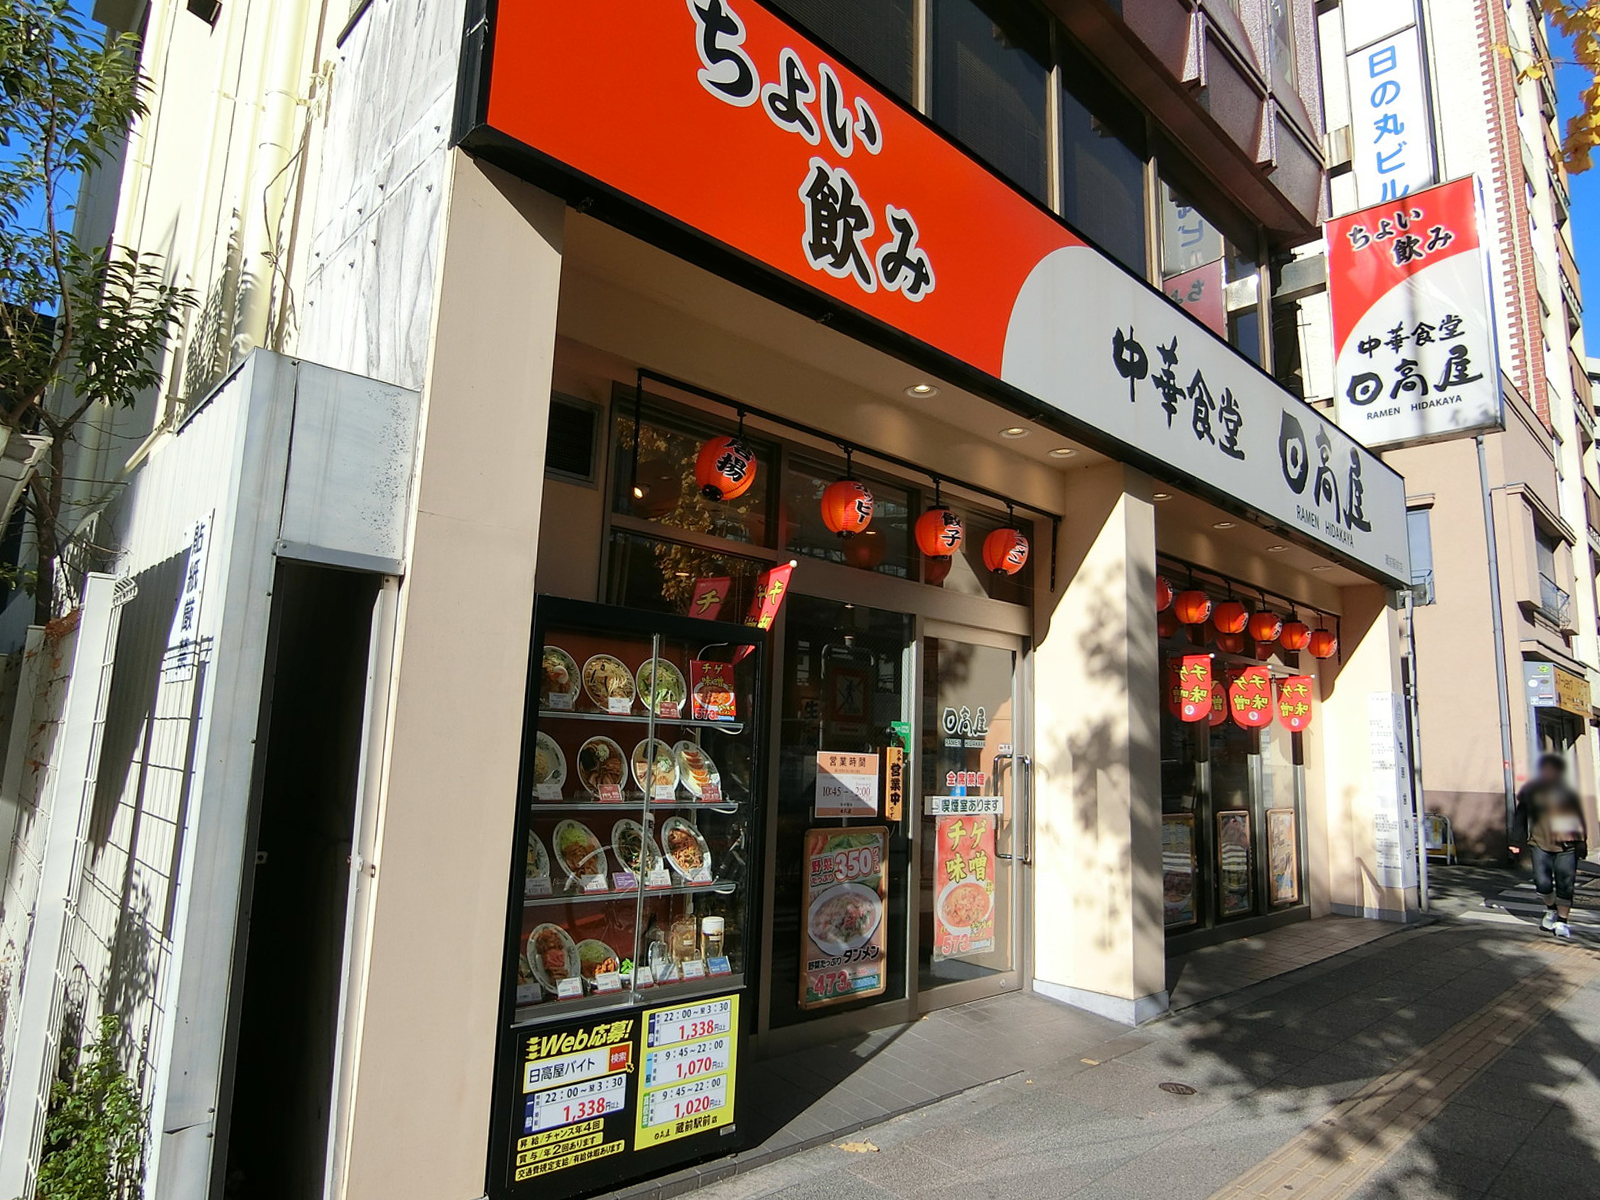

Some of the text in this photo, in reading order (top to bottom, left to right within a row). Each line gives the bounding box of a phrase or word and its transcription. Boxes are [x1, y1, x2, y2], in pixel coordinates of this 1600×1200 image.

[690, 0, 880, 155] ちょい
[1367, 45, 1411, 203] 日の丸ビル
[800, 159, 934, 300] 飲み
[1347, 209, 1423, 250] ちょい
[1392, 225, 1453, 266] 飲み
[1358, 314, 1465, 359] 中華食堂
[1346, 344, 1483, 406] 日高屋
[1366, 394, 1462, 420] RAMEN HIDAKAYA
[1112, 324, 1372, 532] 中華食堂 日高屋
[1296, 505, 1354, 548] RAMEN HIDAKAYA
[943, 706, 988, 736] 日高屋
[829, 756, 866, 767] 営業時間
[890, 762, 902, 806] 営業中
[942, 799, 999, 813] 喫煙室あります
[947, 819, 987, 851] チゲ
[811, 857, 833, 873] 野菜
[834, 847, 872, 881] 350
[945, 850, 989, 883] 味噌
[529, 1058, 595, 1083] 日高屋バイト
